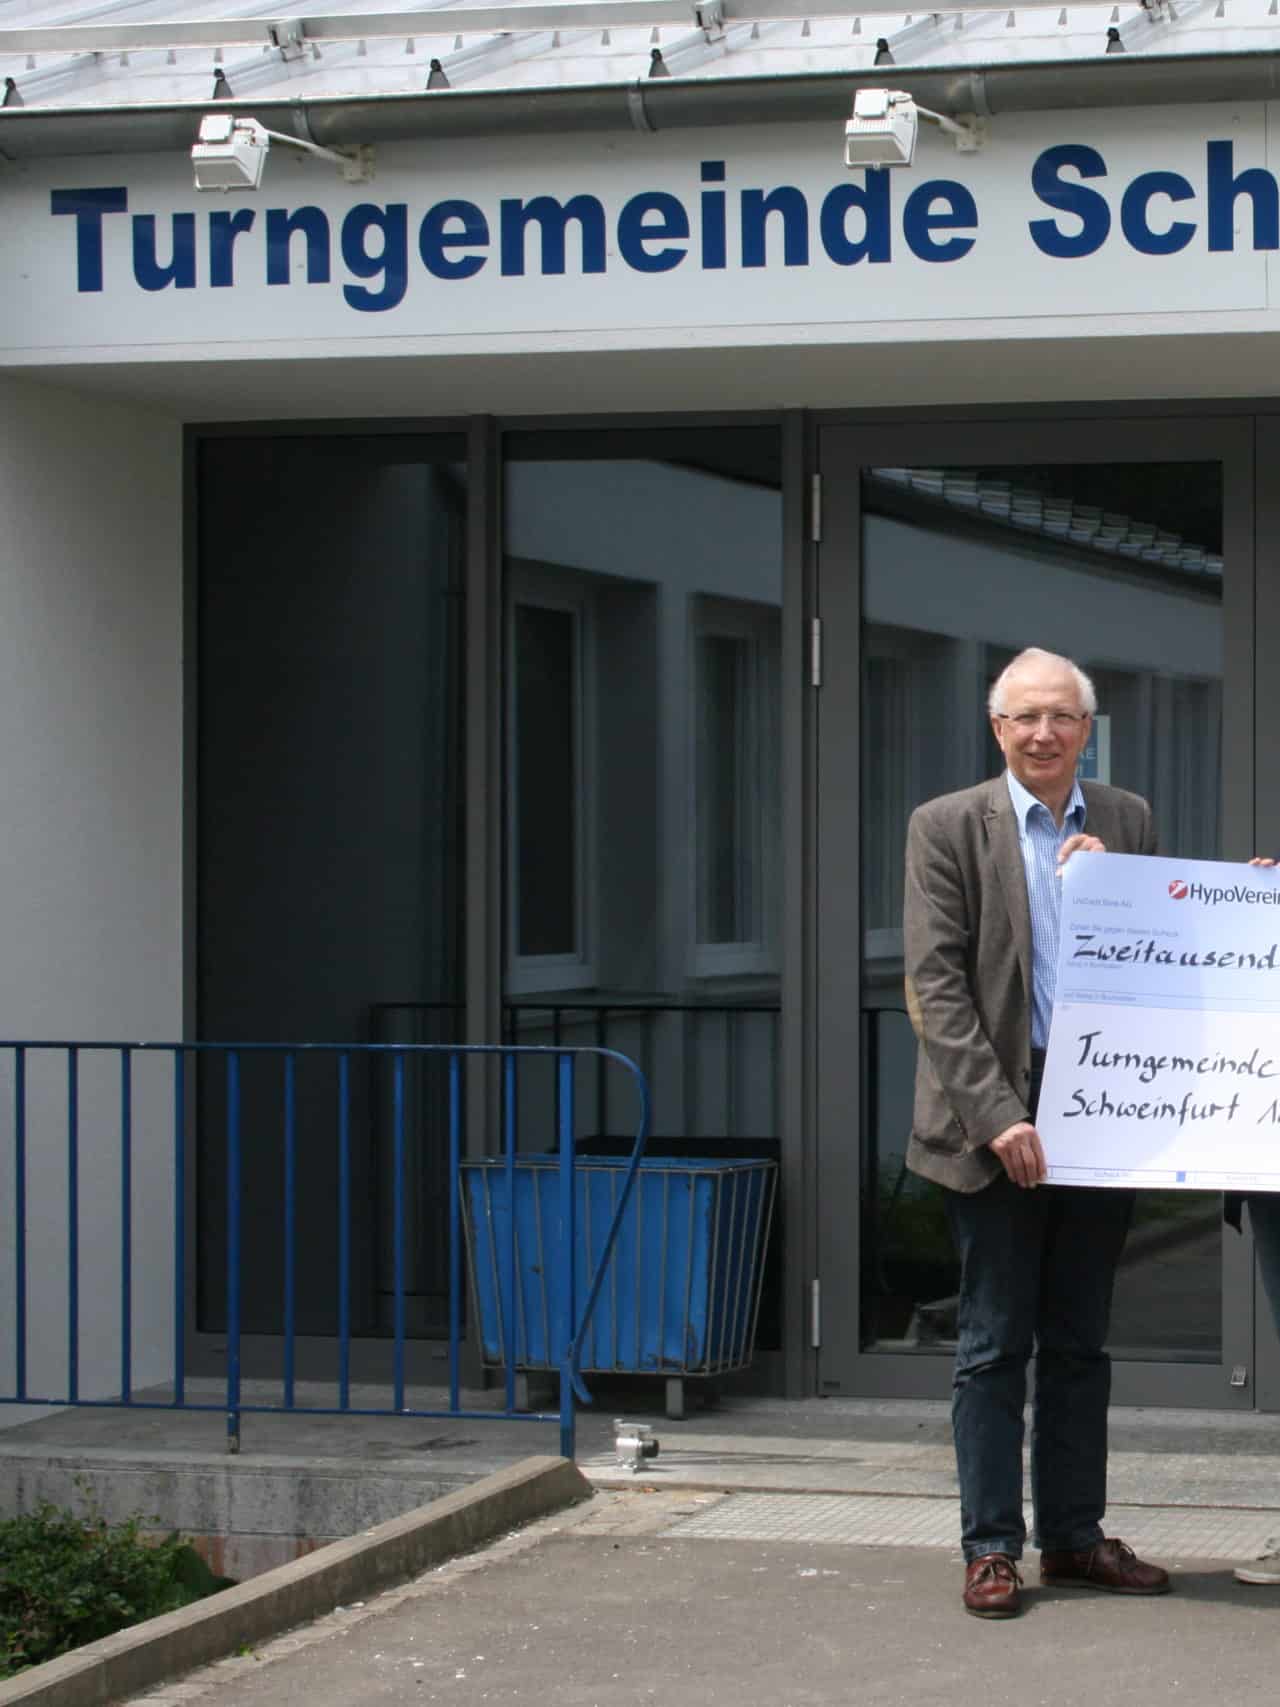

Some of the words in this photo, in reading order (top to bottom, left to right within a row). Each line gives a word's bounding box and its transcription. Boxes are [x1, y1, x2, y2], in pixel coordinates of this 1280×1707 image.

[51, 161, 978, 312] Turngemeinde
[1073, 934, 1280, 970] Zweitausend
[1077, 1031, 1280, 1083] Turngemeinde
[1062, 1088, 1241, 1127] Schweinfurt
